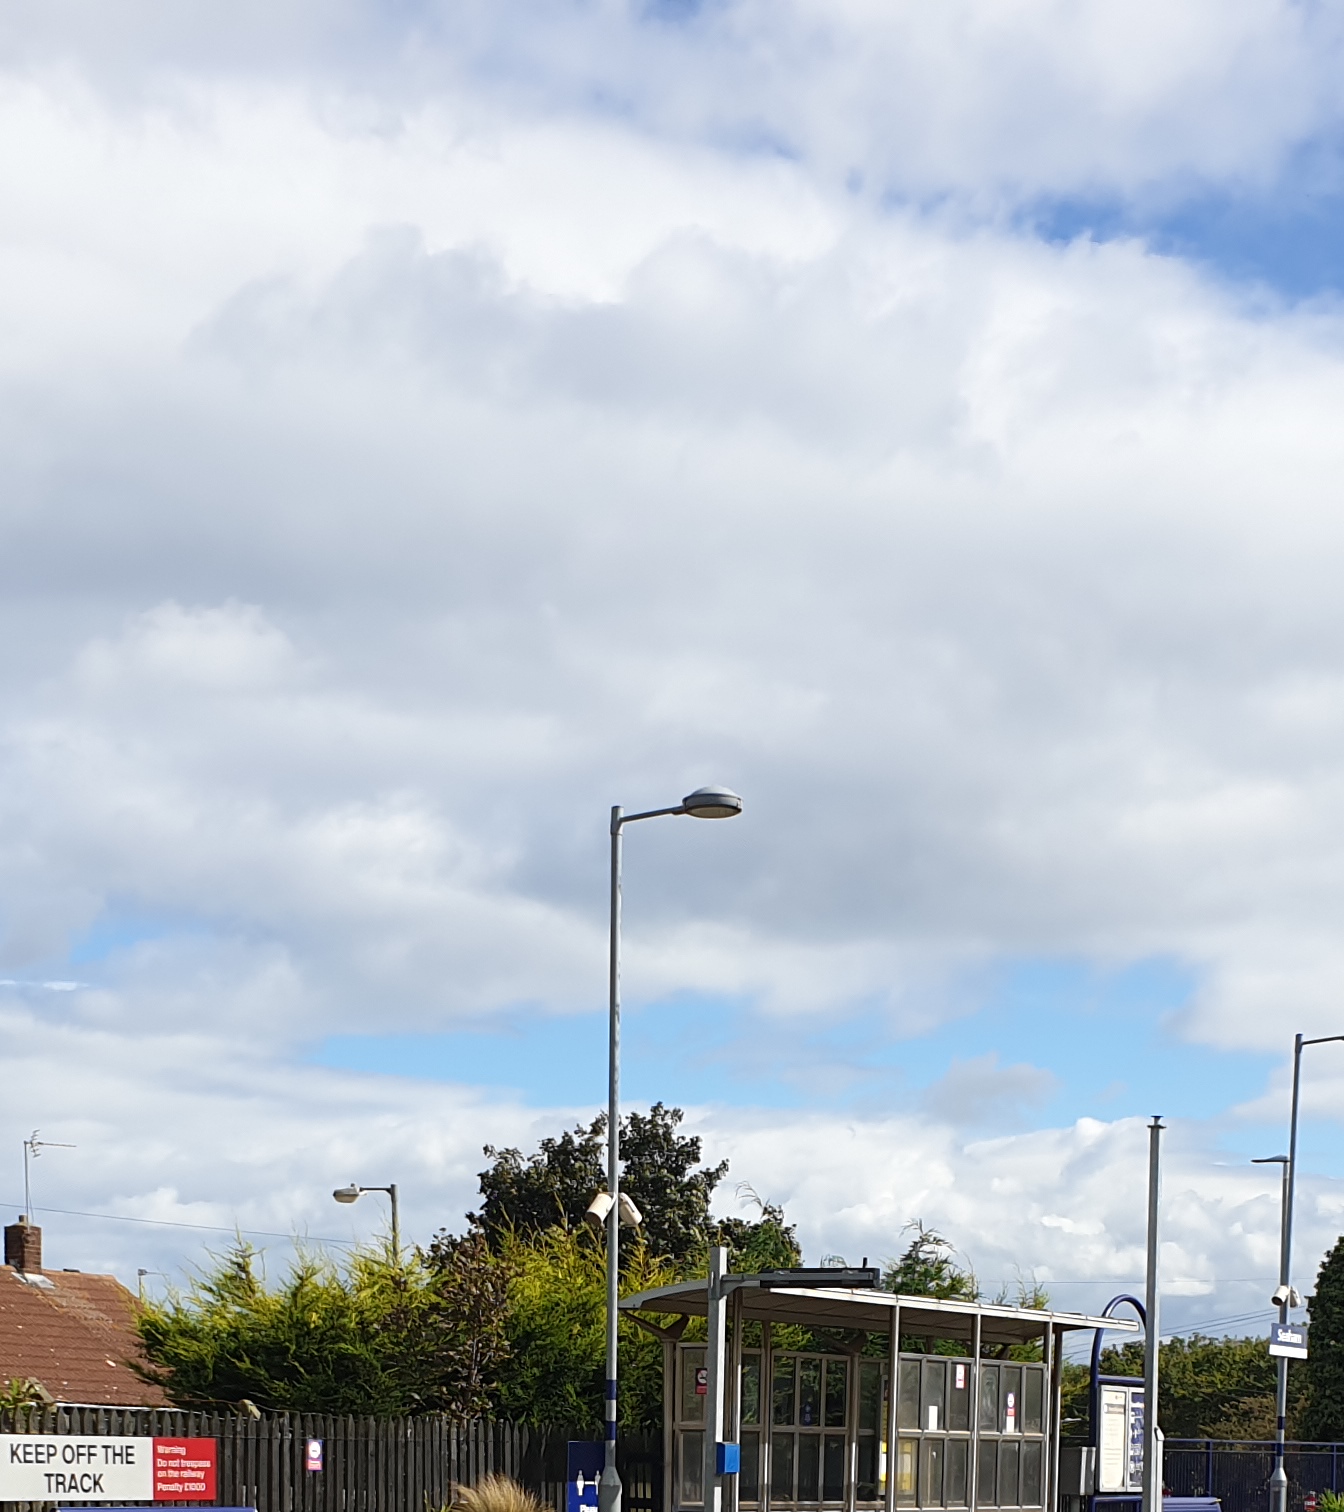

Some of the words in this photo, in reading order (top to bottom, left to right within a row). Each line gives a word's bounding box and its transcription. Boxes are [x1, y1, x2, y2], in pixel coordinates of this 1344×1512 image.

[1277, 1328, 1302, 1344] Seaham
[10, 1443, 57, 1464] KEEP
[62, 1444, 97, 1464] OFF
[101, 1445, 135, 1465] THE
[157, 1445, 186, 1456] Warning
[157, 1458, 167, 1467] Do
[168, 1458, 180, 1467] not
[167, 1469, 180, 1477] the
[180, 1469, 205, 1480] railway
[44, 1473, 105, 1493] TRACK
[157, 1482, 183, 1493] Penalty
